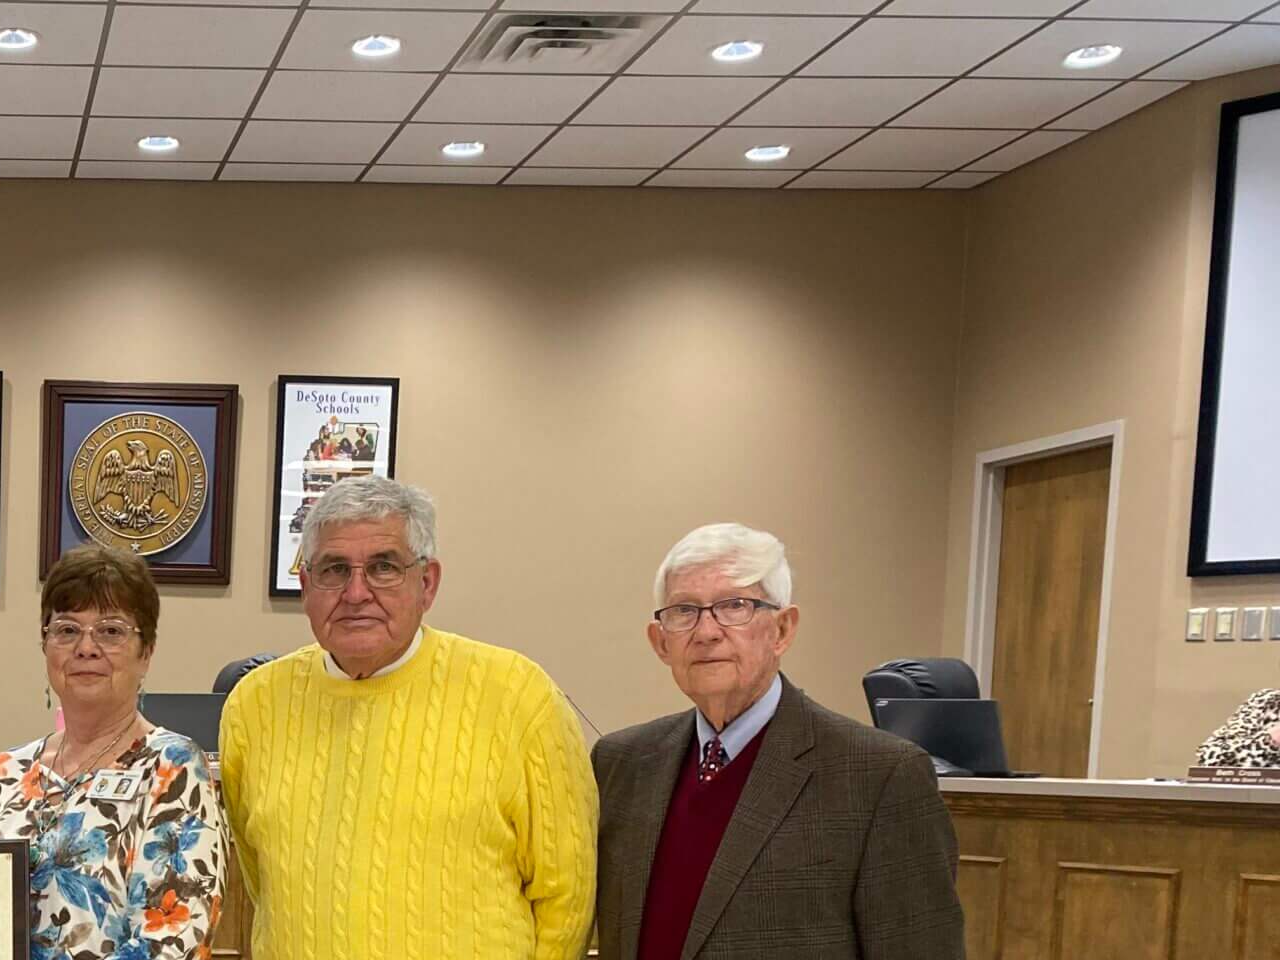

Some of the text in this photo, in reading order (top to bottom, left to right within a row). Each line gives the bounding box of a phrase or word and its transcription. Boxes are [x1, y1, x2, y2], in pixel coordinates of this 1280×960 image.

[296, 390, 381, 406] DeSoto County
[315, 402, 360, 414] Schools
[103, 422, 118, 437] OF
[121, 416, 149, 429] THE
[156, 420, 189, 450] STATE
[78, 438, 100, 470] SEAL
[188, 451, 200, 467] OF
[160, 472, 204, 545] MISSISSIPPI
